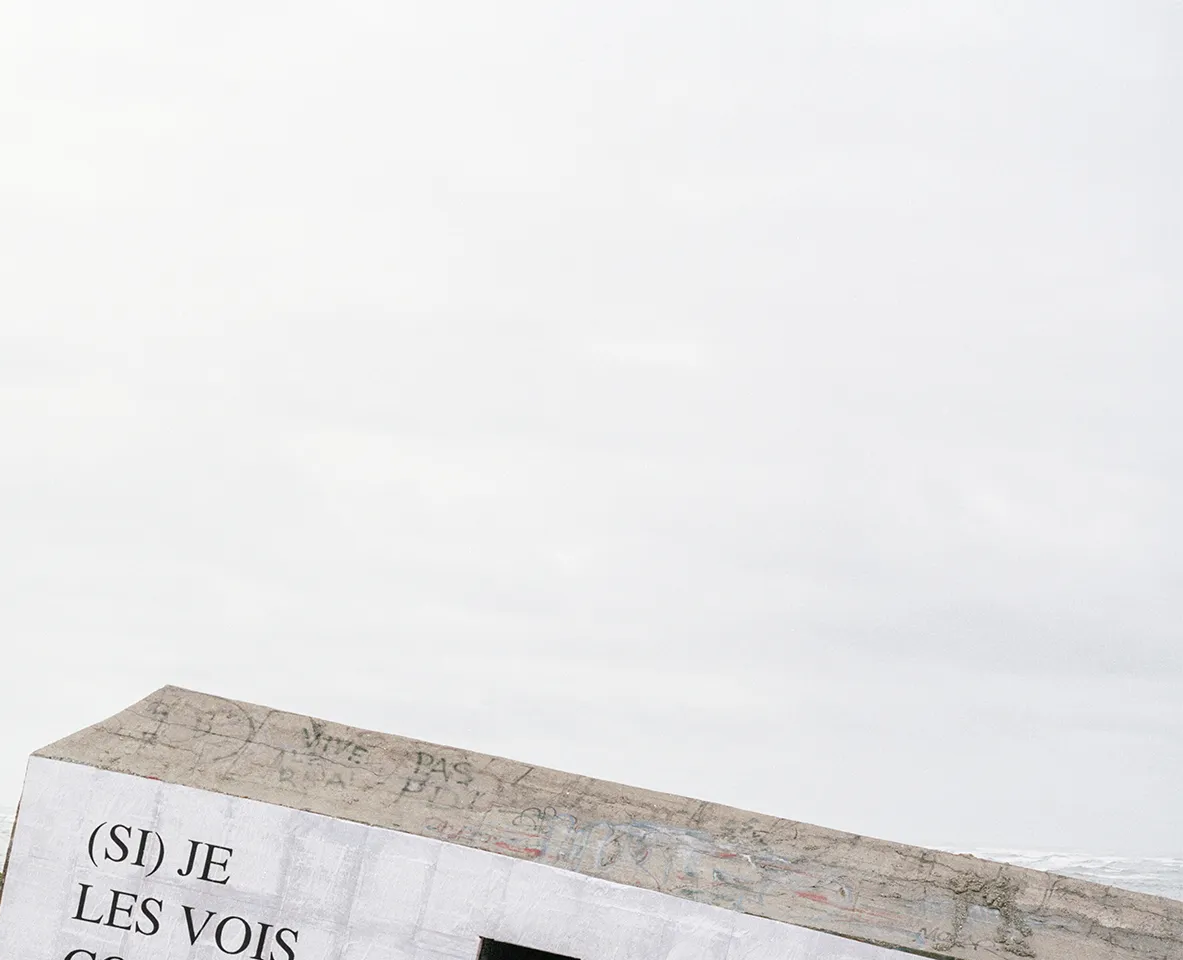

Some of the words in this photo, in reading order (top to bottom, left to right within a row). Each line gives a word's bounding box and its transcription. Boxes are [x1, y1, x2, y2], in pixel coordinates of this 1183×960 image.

[413, 750, 474, 787] PAS
[87, 821, 165, 877] (SI)
[176, 839, 234, 885] JE
[71, 882, 163, 936] LES
